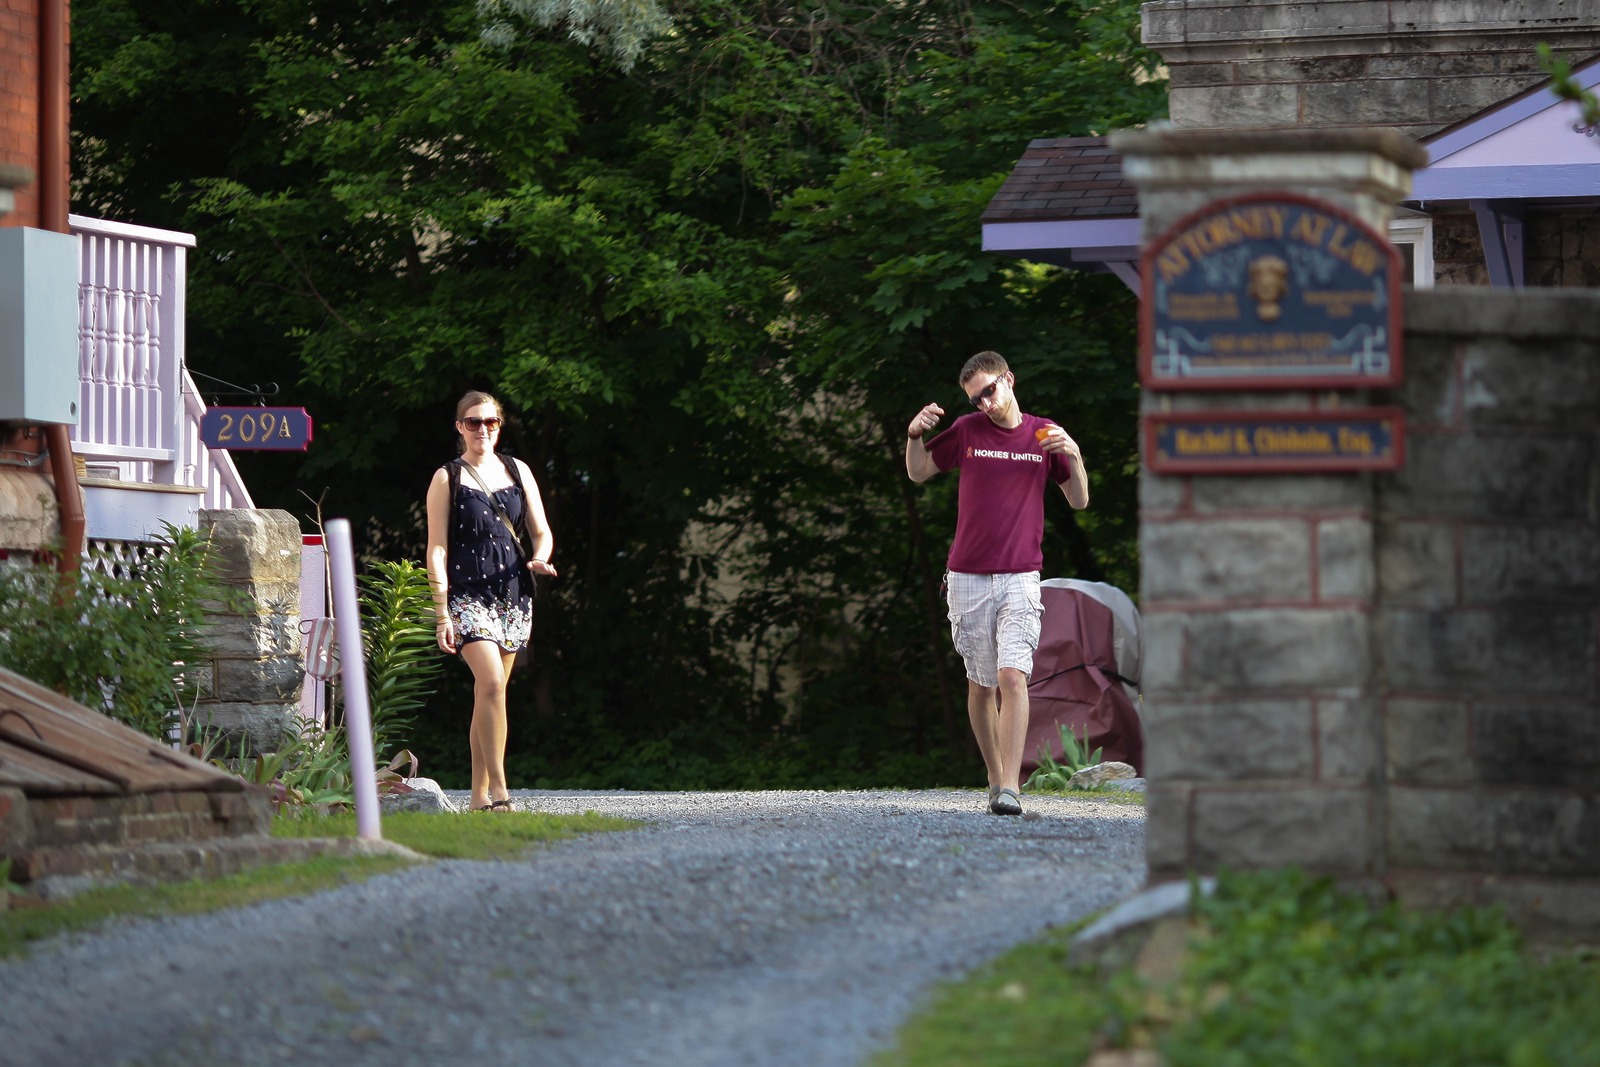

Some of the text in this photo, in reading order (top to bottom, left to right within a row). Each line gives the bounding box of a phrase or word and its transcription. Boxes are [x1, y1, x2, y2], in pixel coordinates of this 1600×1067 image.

[1157, 207, 1382, 284] ATTORNEY AT LAW
[218, 413, 291, 442] 209A
[974, 449, 1043, 462] HOKIES UNITED
